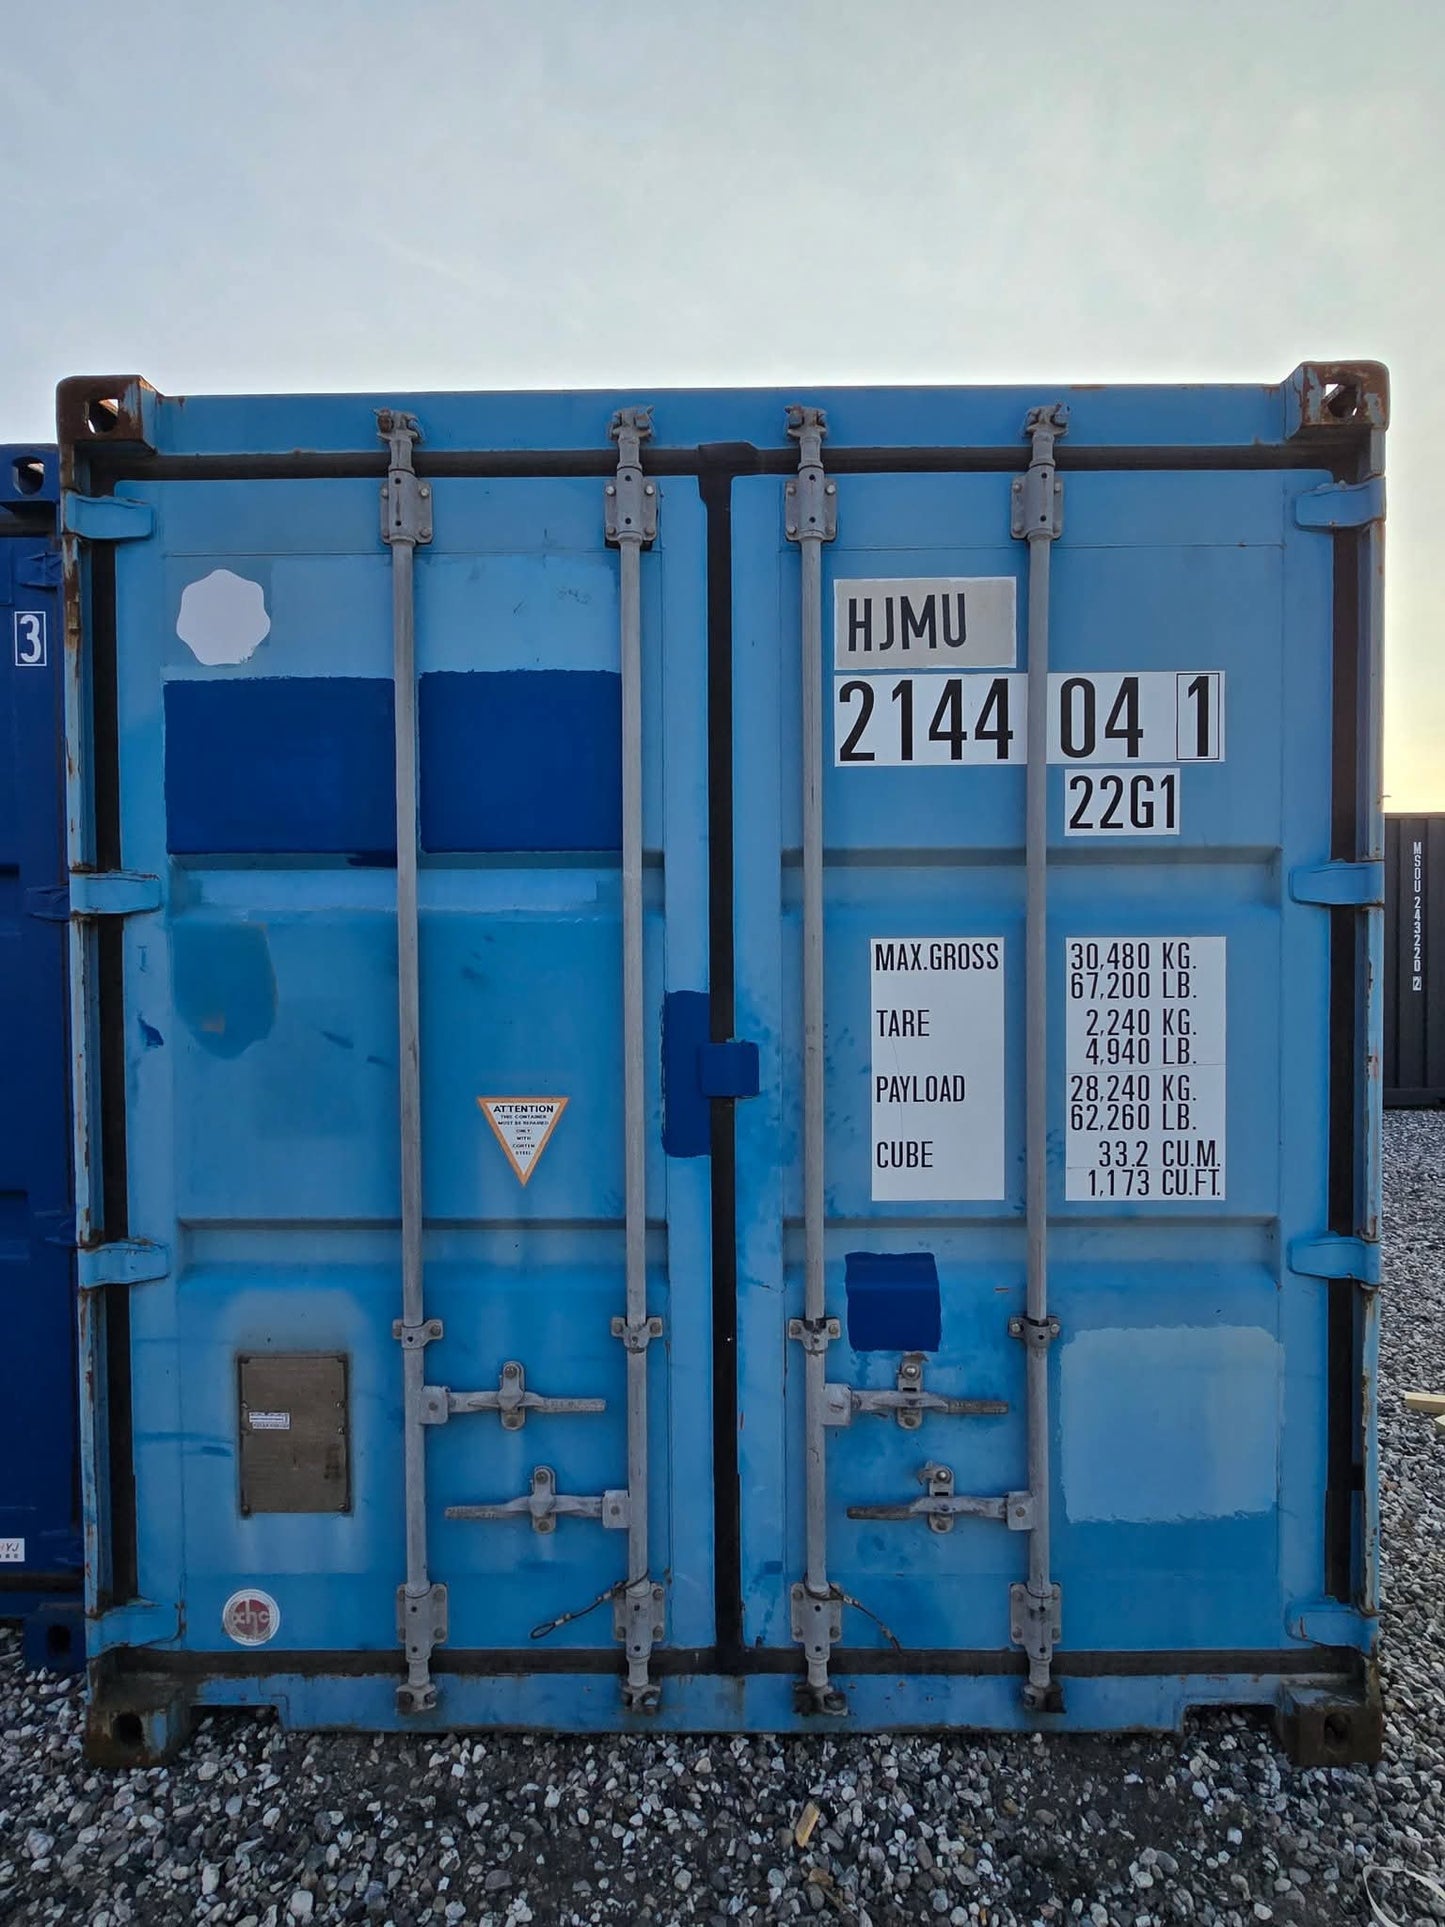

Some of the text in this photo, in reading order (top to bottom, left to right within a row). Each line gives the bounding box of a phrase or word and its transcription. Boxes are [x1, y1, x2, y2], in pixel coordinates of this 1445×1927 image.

[848, 593, 967, 652] HJMU
[20, 614, 41, 663] 3
[1188, 675, 1210, 757] 1
[1069, 774, 1176, 829] 22G1
[1413, 842, 1422, 893] MSOU
[874, 943, 1000, 971] MAX.GROSS
[1070, 942, 1198, 970] 30,480 KG.
[1070, 972, 1198, 1000] 67,200 LB.
[876, 1009, 931, 1037] TARE
[1086, 1008, 1198, 1036] 2,240 KG.
[1085, 1038, 1198, 1066] 4,940 LB.
[876, 1075, 966, 1102] PAYLOAD
[1070, 1074, 1198, 1102] 28,240 KG.
[494, 1104, 553, 1112] ATTENTION
[1070, 1104, 1198, 1132] 62,260 LB.
[876, 1141, 934, 1168] CUBE
[1098, 1140, 1221, 1167] 33.2 CU.M.
[1088, 1169, 1221, 1197] 1,173 CU.FT.
